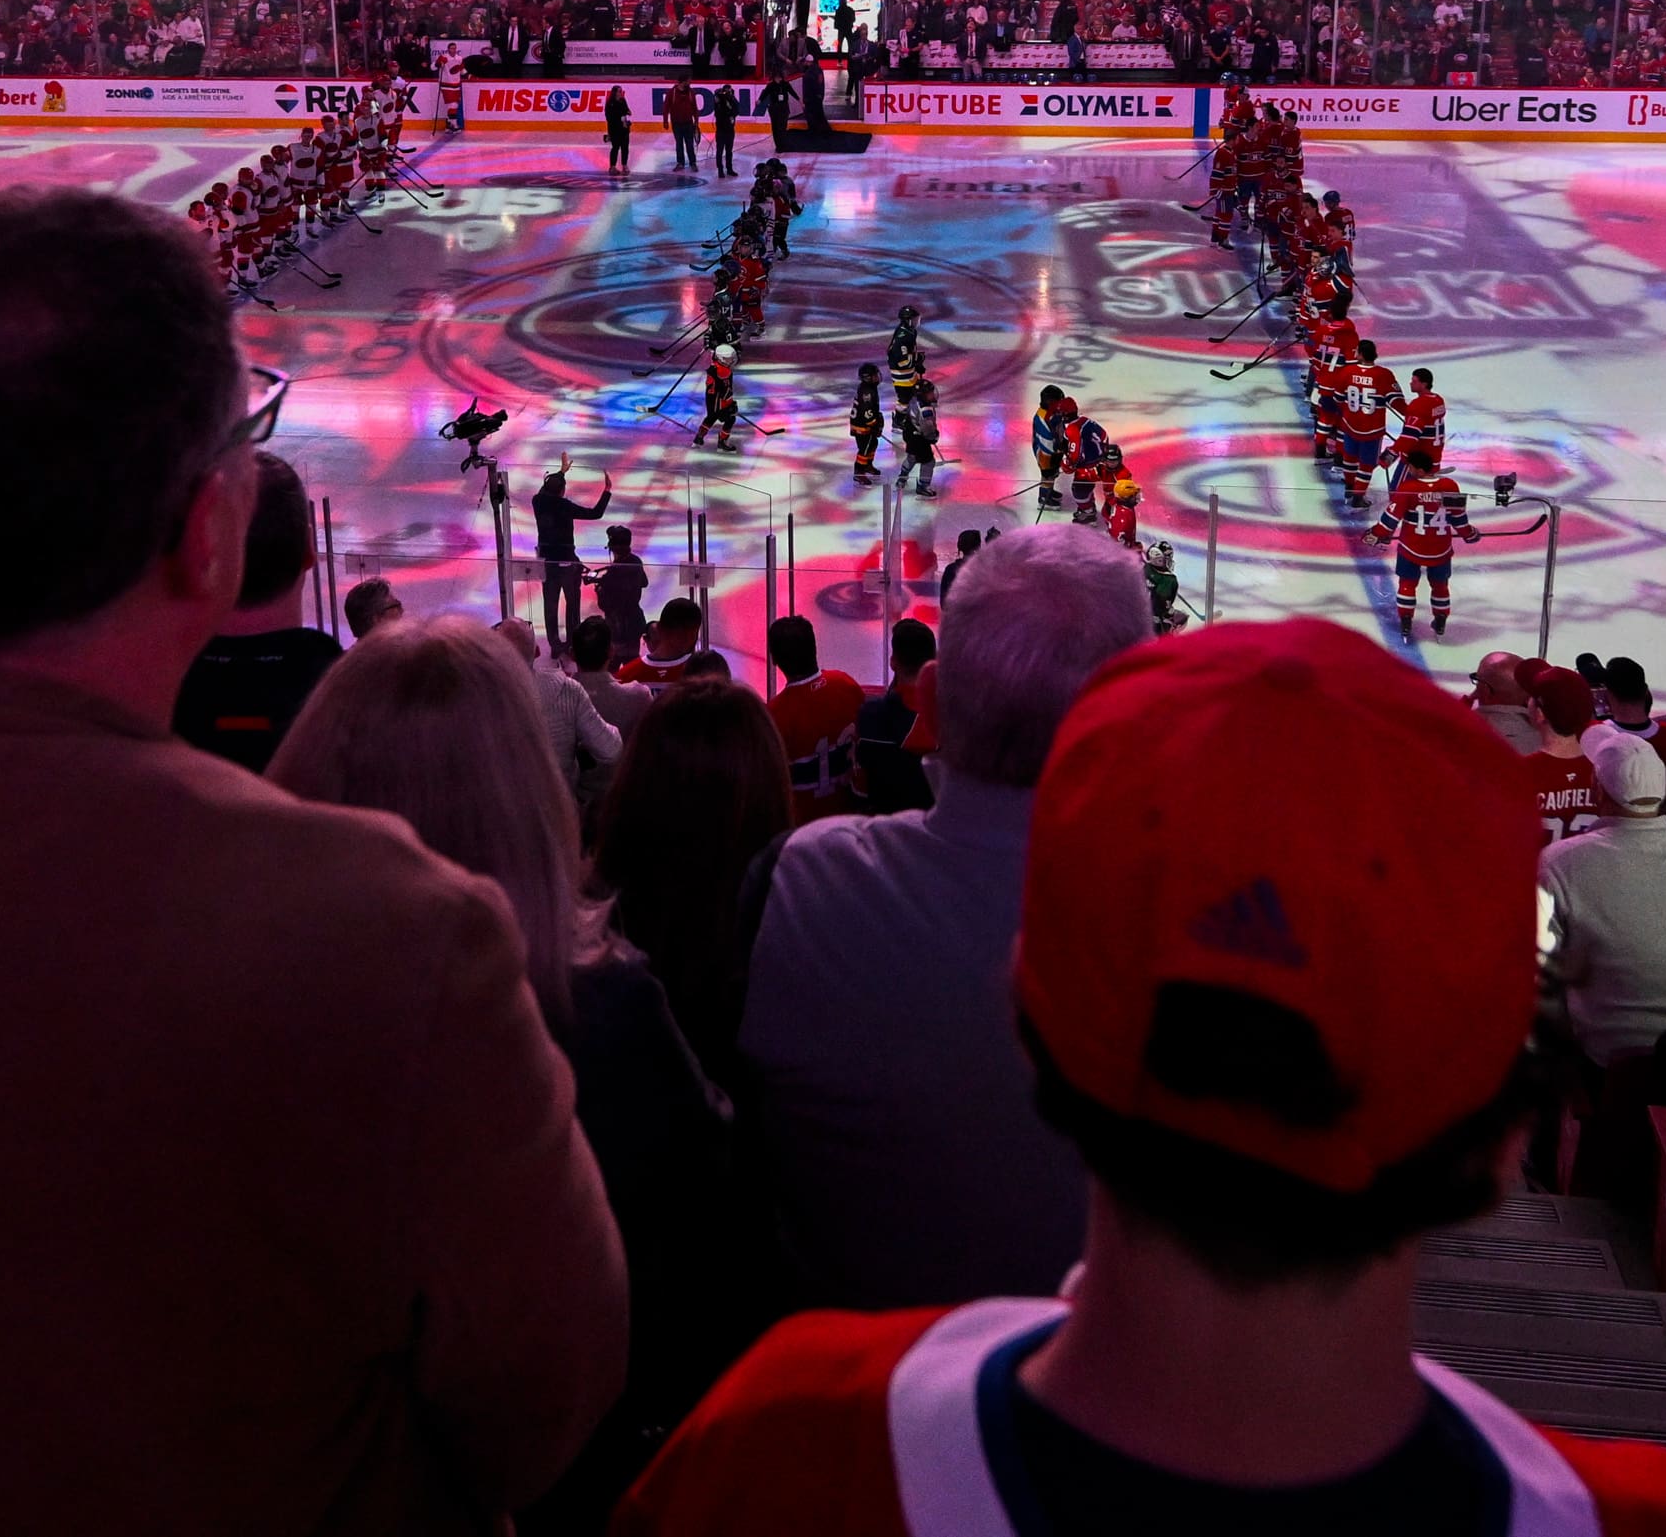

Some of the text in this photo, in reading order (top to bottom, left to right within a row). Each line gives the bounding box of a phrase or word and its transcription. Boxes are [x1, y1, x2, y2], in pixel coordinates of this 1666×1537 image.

[864, 93, 1001, 115] TRUCTUBE
[1044, 94, 1149, 118] OLYMEL
[1254, 97, 1400, 113] ÂTON ROUGE
[1432, 96, 1598, 123] Uber Eats
[1300, 114, 1330, 123] HOUSE
[931, 176, 1093, 195] intact
[1351, 374, 1374, 386] TEXIER
[1346, 386, 1378, 414] 85
[1414, 504, 1449, 537] 14
[1536, 786, 1598, 811] CAUFIEL
